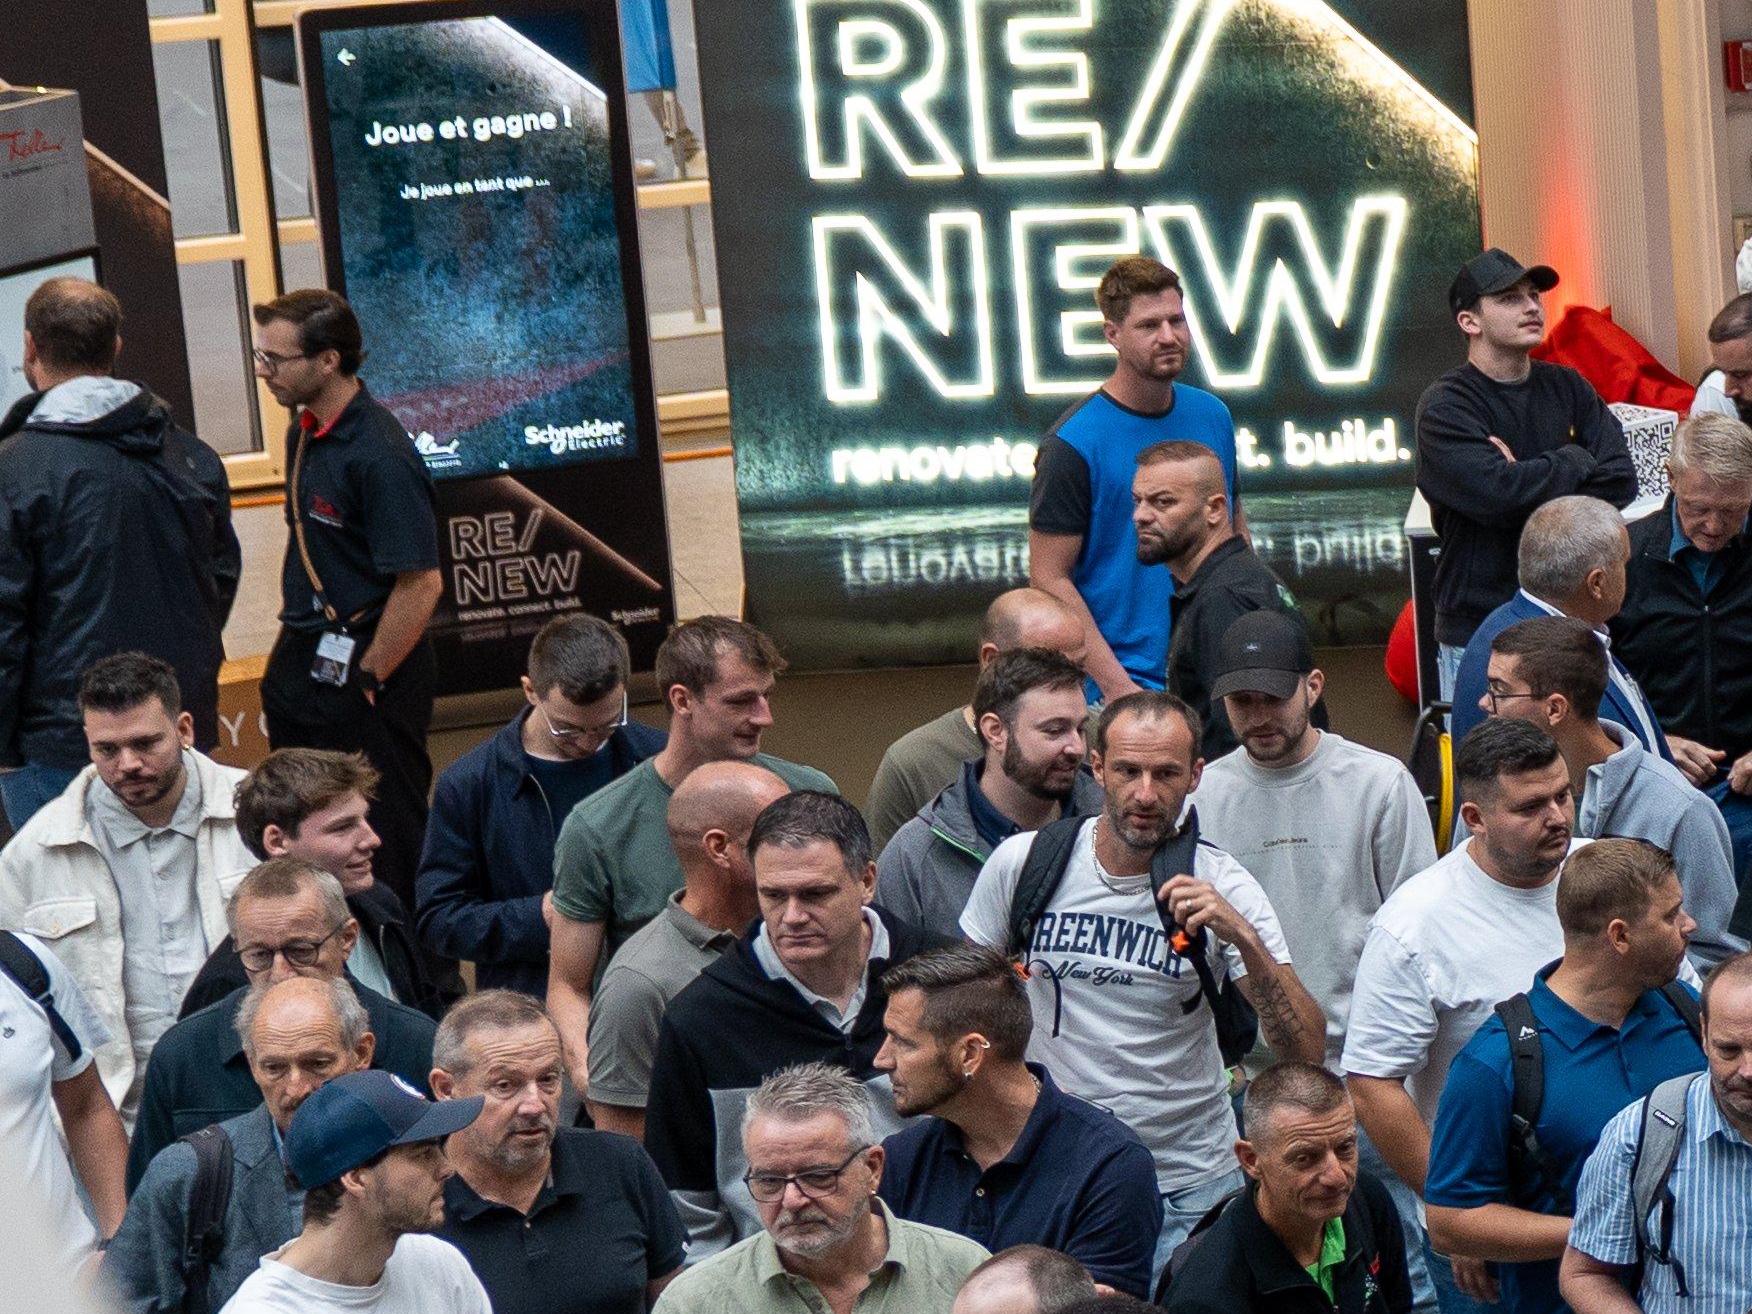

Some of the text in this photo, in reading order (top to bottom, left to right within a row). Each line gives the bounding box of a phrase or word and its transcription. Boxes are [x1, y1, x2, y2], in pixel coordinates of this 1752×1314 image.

[365, 120, 435, 147] Joue
[439, 115, 469, 140] et
[473, 110, 558, 142] gagne
[811, 196, 1407, 402] NEW
[523, 418, 626, 446] Schneider
[1283, 417, 1412, 466] build.
[449, 508, 544, 560] RE/
[453, 551, 582, 606] NEW
[1042, 960, 1133, 986] New York
